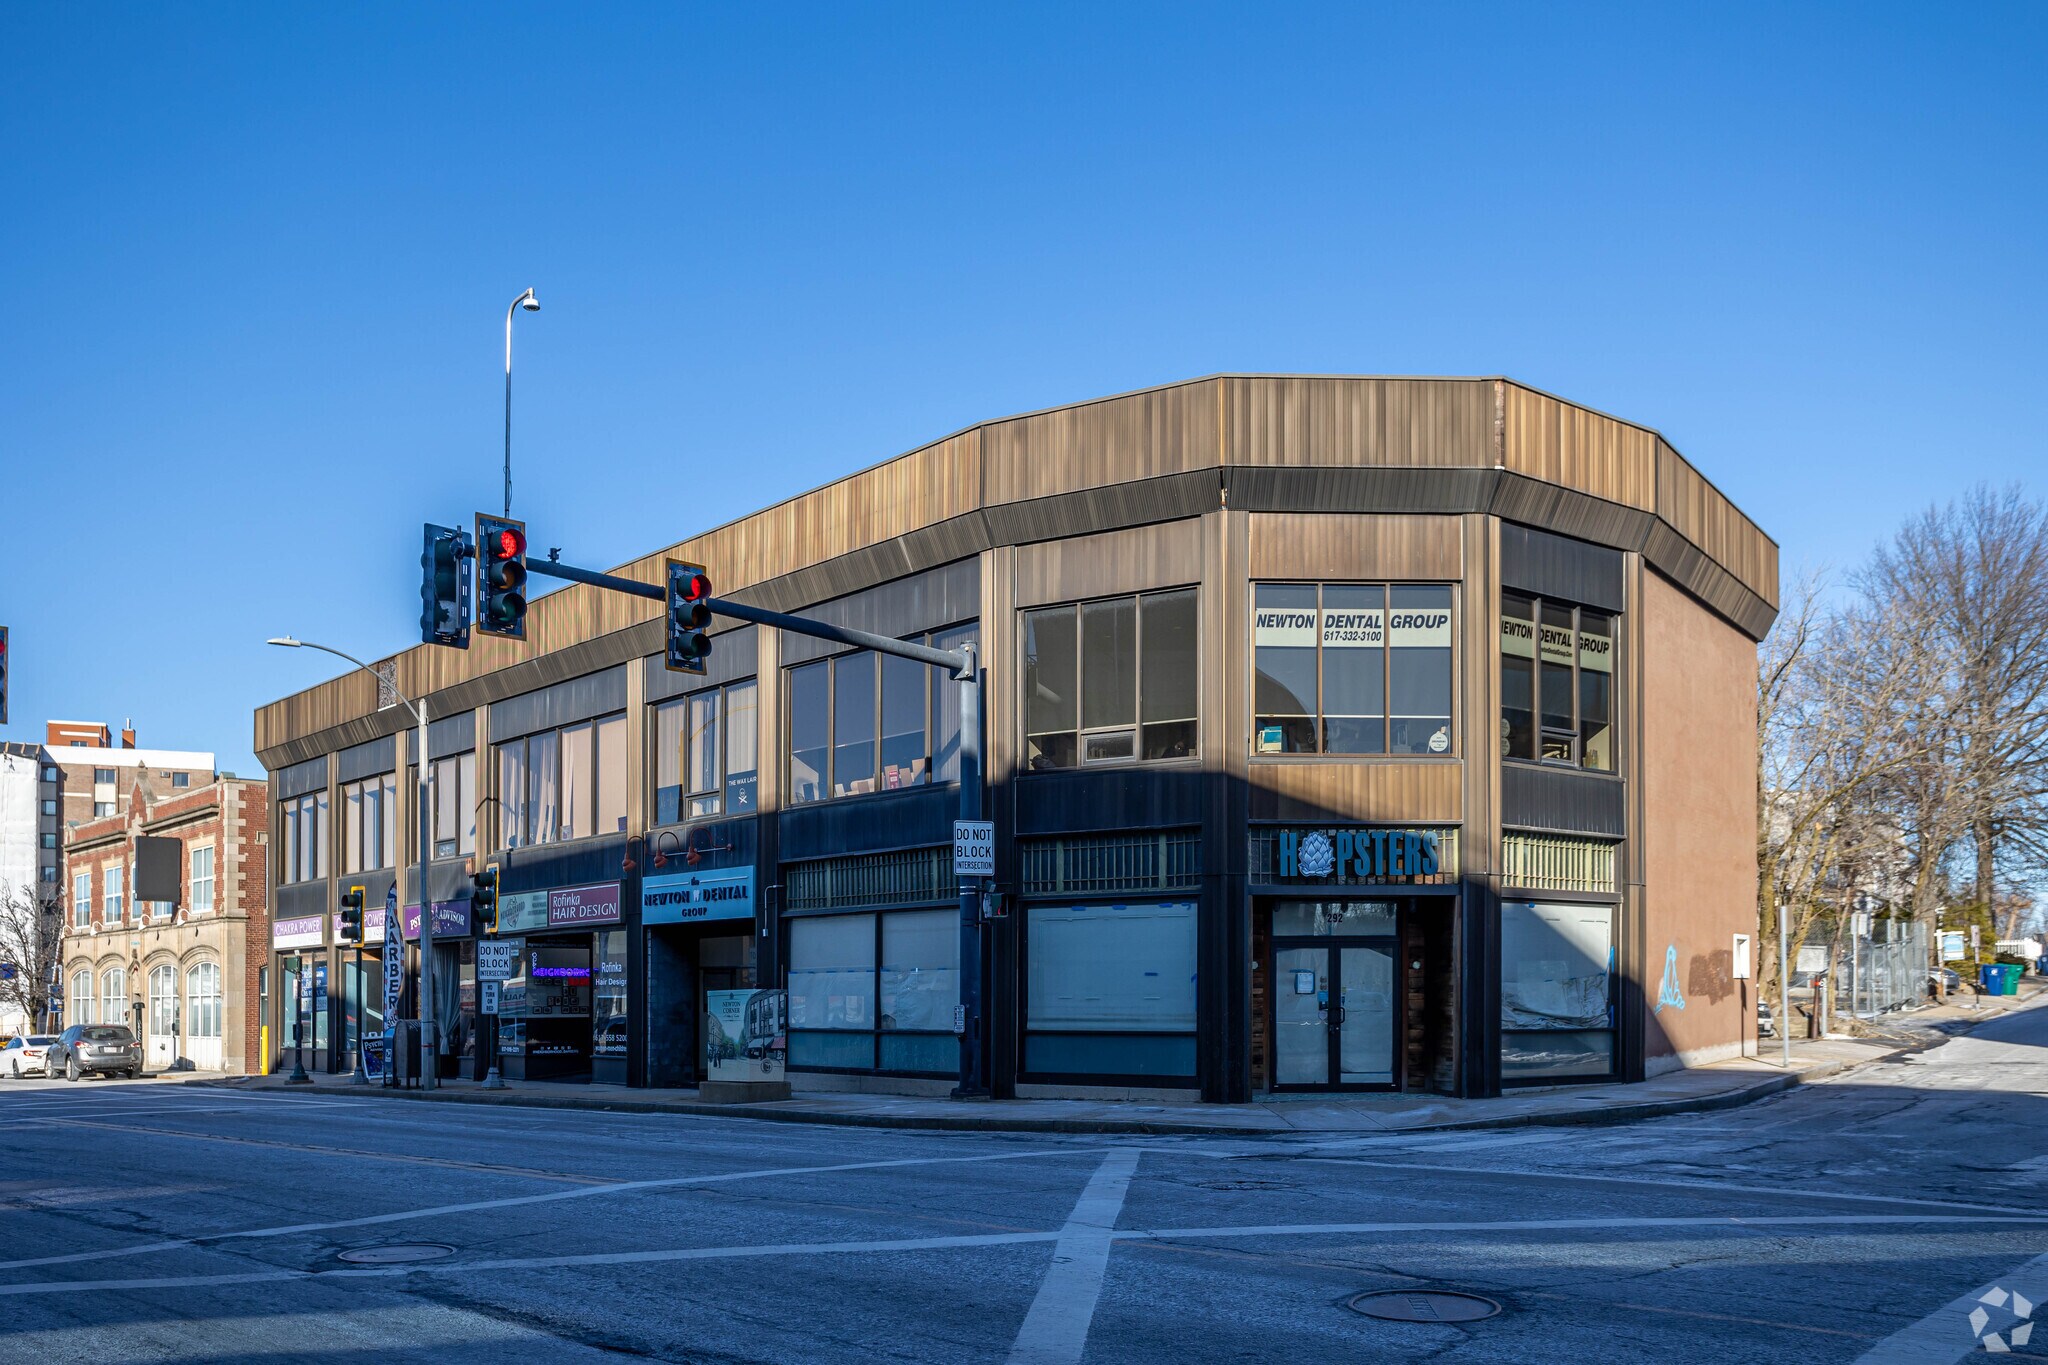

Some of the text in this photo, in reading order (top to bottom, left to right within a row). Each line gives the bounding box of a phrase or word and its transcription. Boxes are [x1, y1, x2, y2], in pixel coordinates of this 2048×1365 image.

[1256, 614, 1448, 629] NEWTON DENTAL GROUP
[1323, 631, 1382, 642] 617-332-3100
[1540, 628, 1572, 648] DENTAL
[1579, 637, 1610, 655] GROUP
[957, 828, 991, 841] DO NOT
[957, 846, 992, 858] BLOCK
[957, 862, 993, 870] INTERSECTION
[552, 893, 581, 908] Rofinka
[644, 885, 749, 907] NEWTON DENTAL
[439, 909, 465, 926] ADVISOR
[553, 907, 576, 920] HAIR
[579, 902, 617, 917] DESIGN
[682, 907, 708, 918] GROUP
[1327, 913, 1343, 923] 292
[364, 911, 386, 927] POWE
[275, 921, 299, 936] CHAKRA
[299, 919, 321, 933] POWER
[480, 946, 491, 956] DO
[493, 946, 509, 956] NOT
[388, 915, 400, 1010] BARBER
[480, 958, 509, 968] BLOCK
[387, 1013, 399, 1028] SHO
